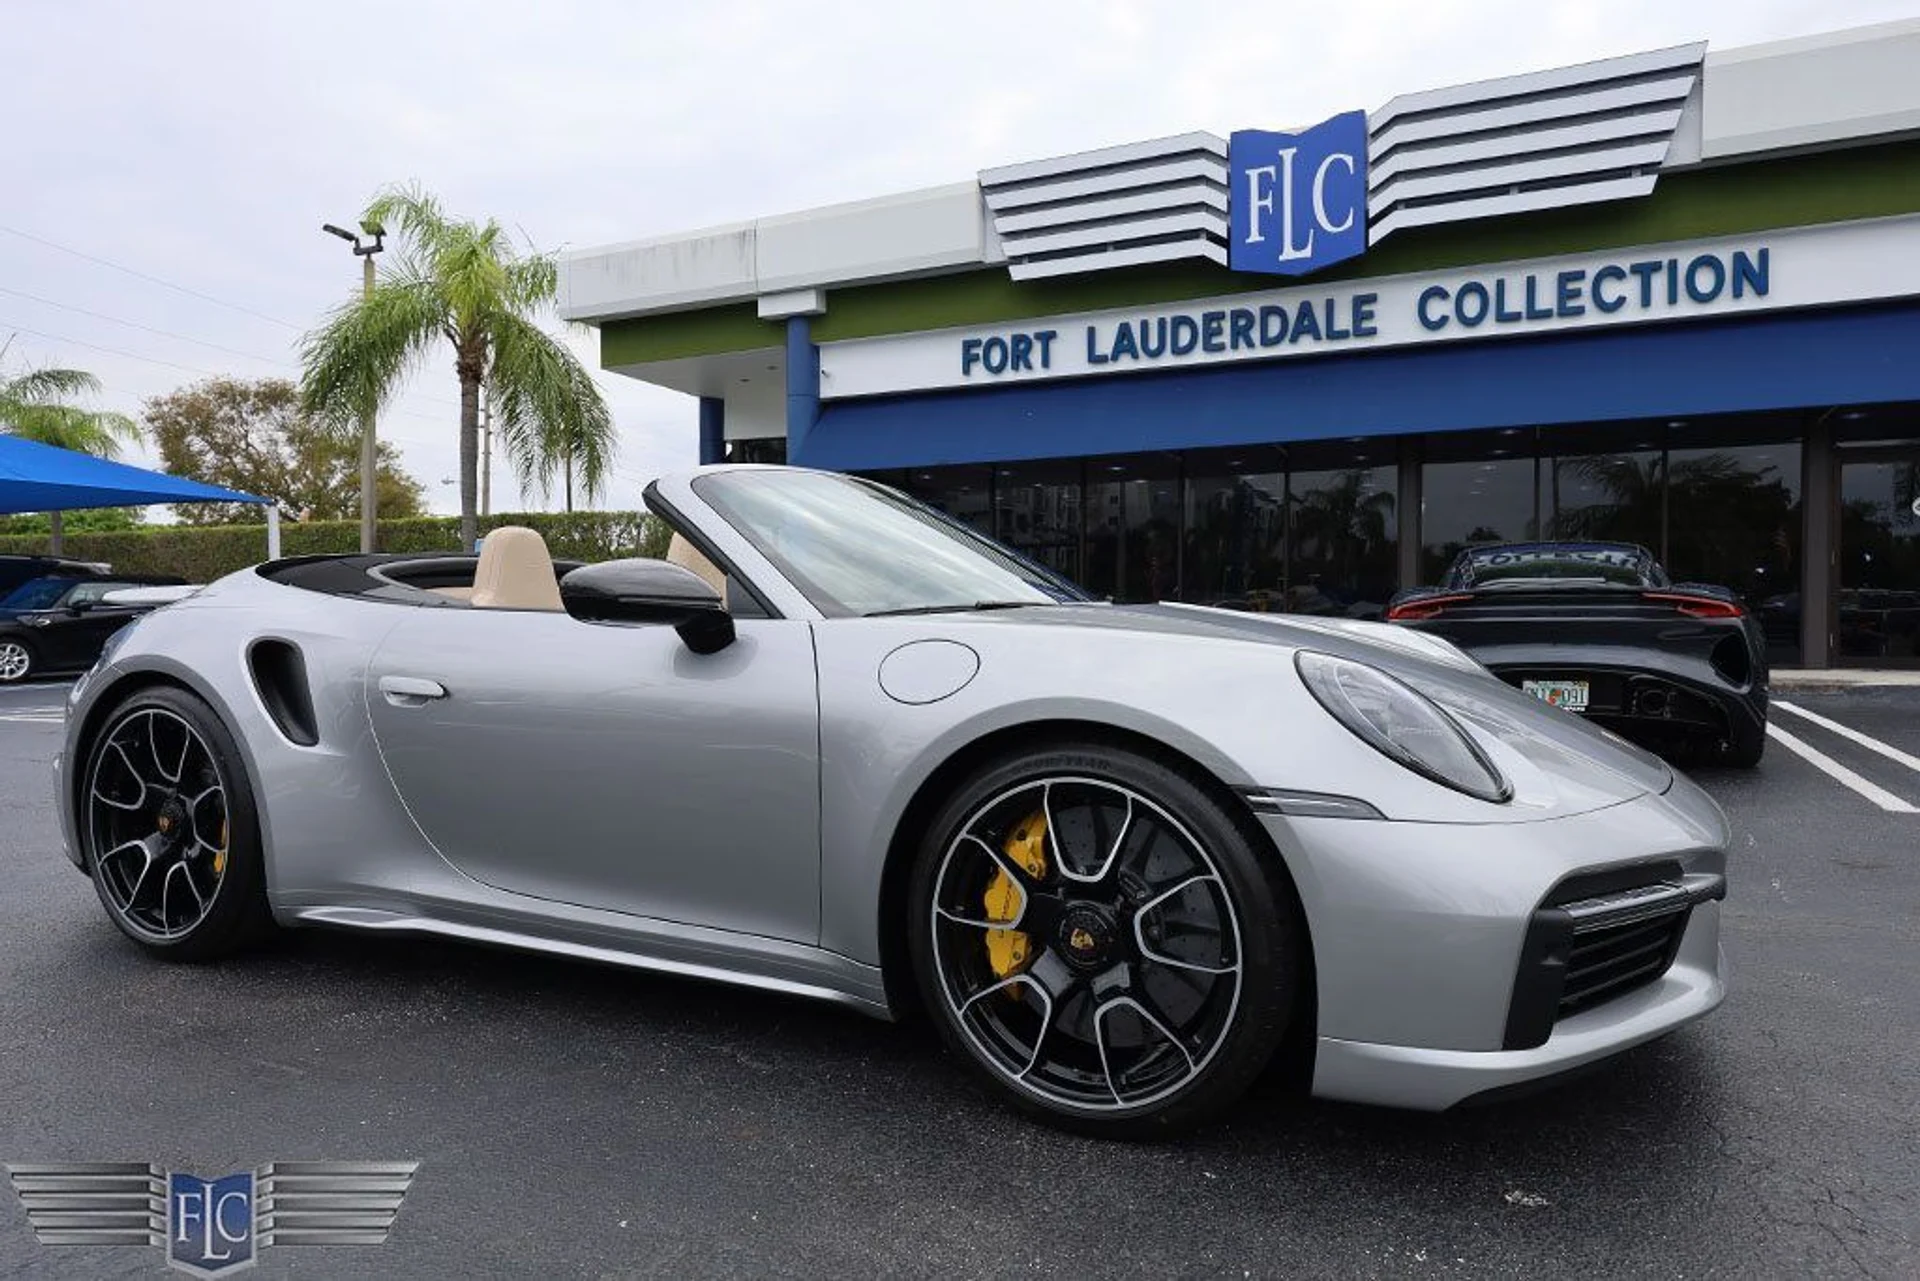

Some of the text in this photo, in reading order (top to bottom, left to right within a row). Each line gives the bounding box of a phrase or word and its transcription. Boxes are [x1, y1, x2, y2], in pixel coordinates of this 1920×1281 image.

[1244, 146, 1355, 263] FLC
[961, 247, 1770, 376] FORT LAUDERDALE COLLECTION
